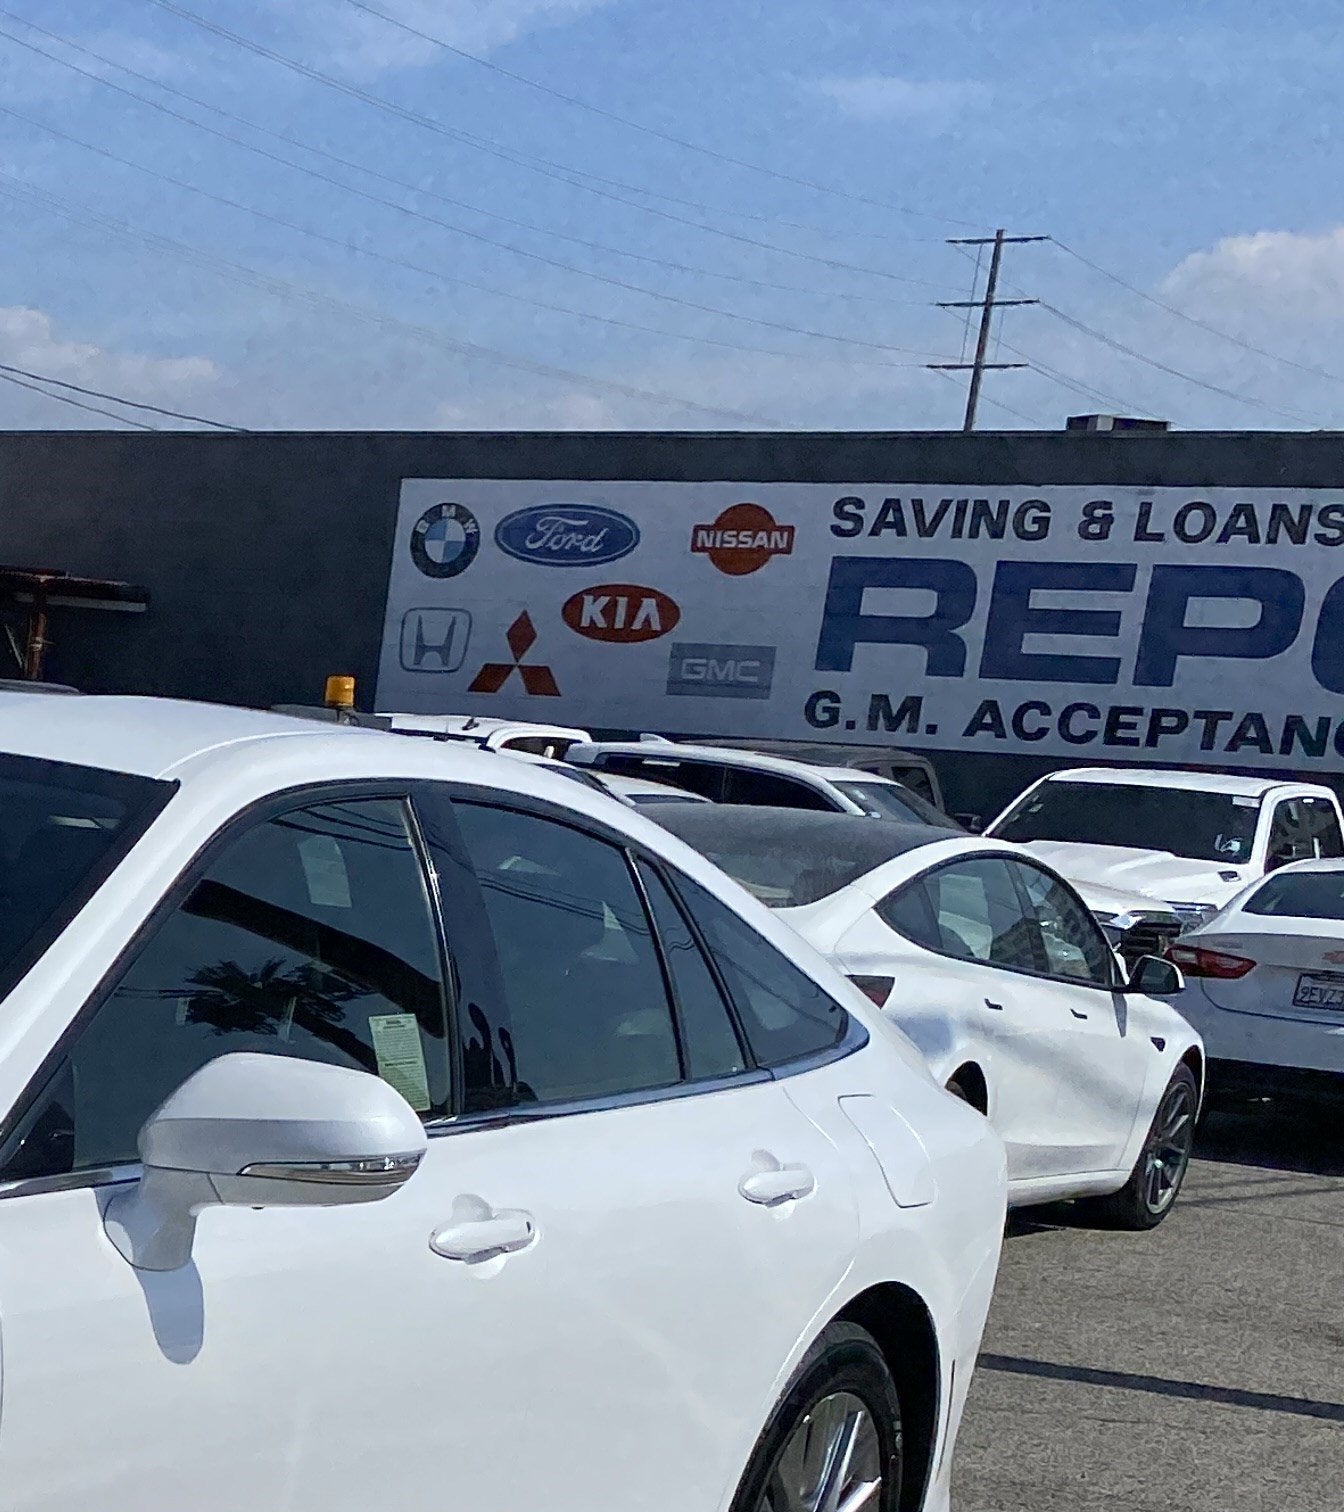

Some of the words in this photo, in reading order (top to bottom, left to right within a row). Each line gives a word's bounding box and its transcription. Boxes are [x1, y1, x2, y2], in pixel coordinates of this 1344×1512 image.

[525, 516, 608, 553] Ford
[830, 496, 1051, 541] SAVING
[1078, 501, 1115, 541] &
[696, 529, 789, 549] NISSAN
[580, 595, 662, 632] KIA
[814, 555, 1344, 694] REP
[680, 657, 761, 683] GMC
[803, 689, 939, 734] G.M.
[963, 699, 1344, 759] ACCEPTAN
